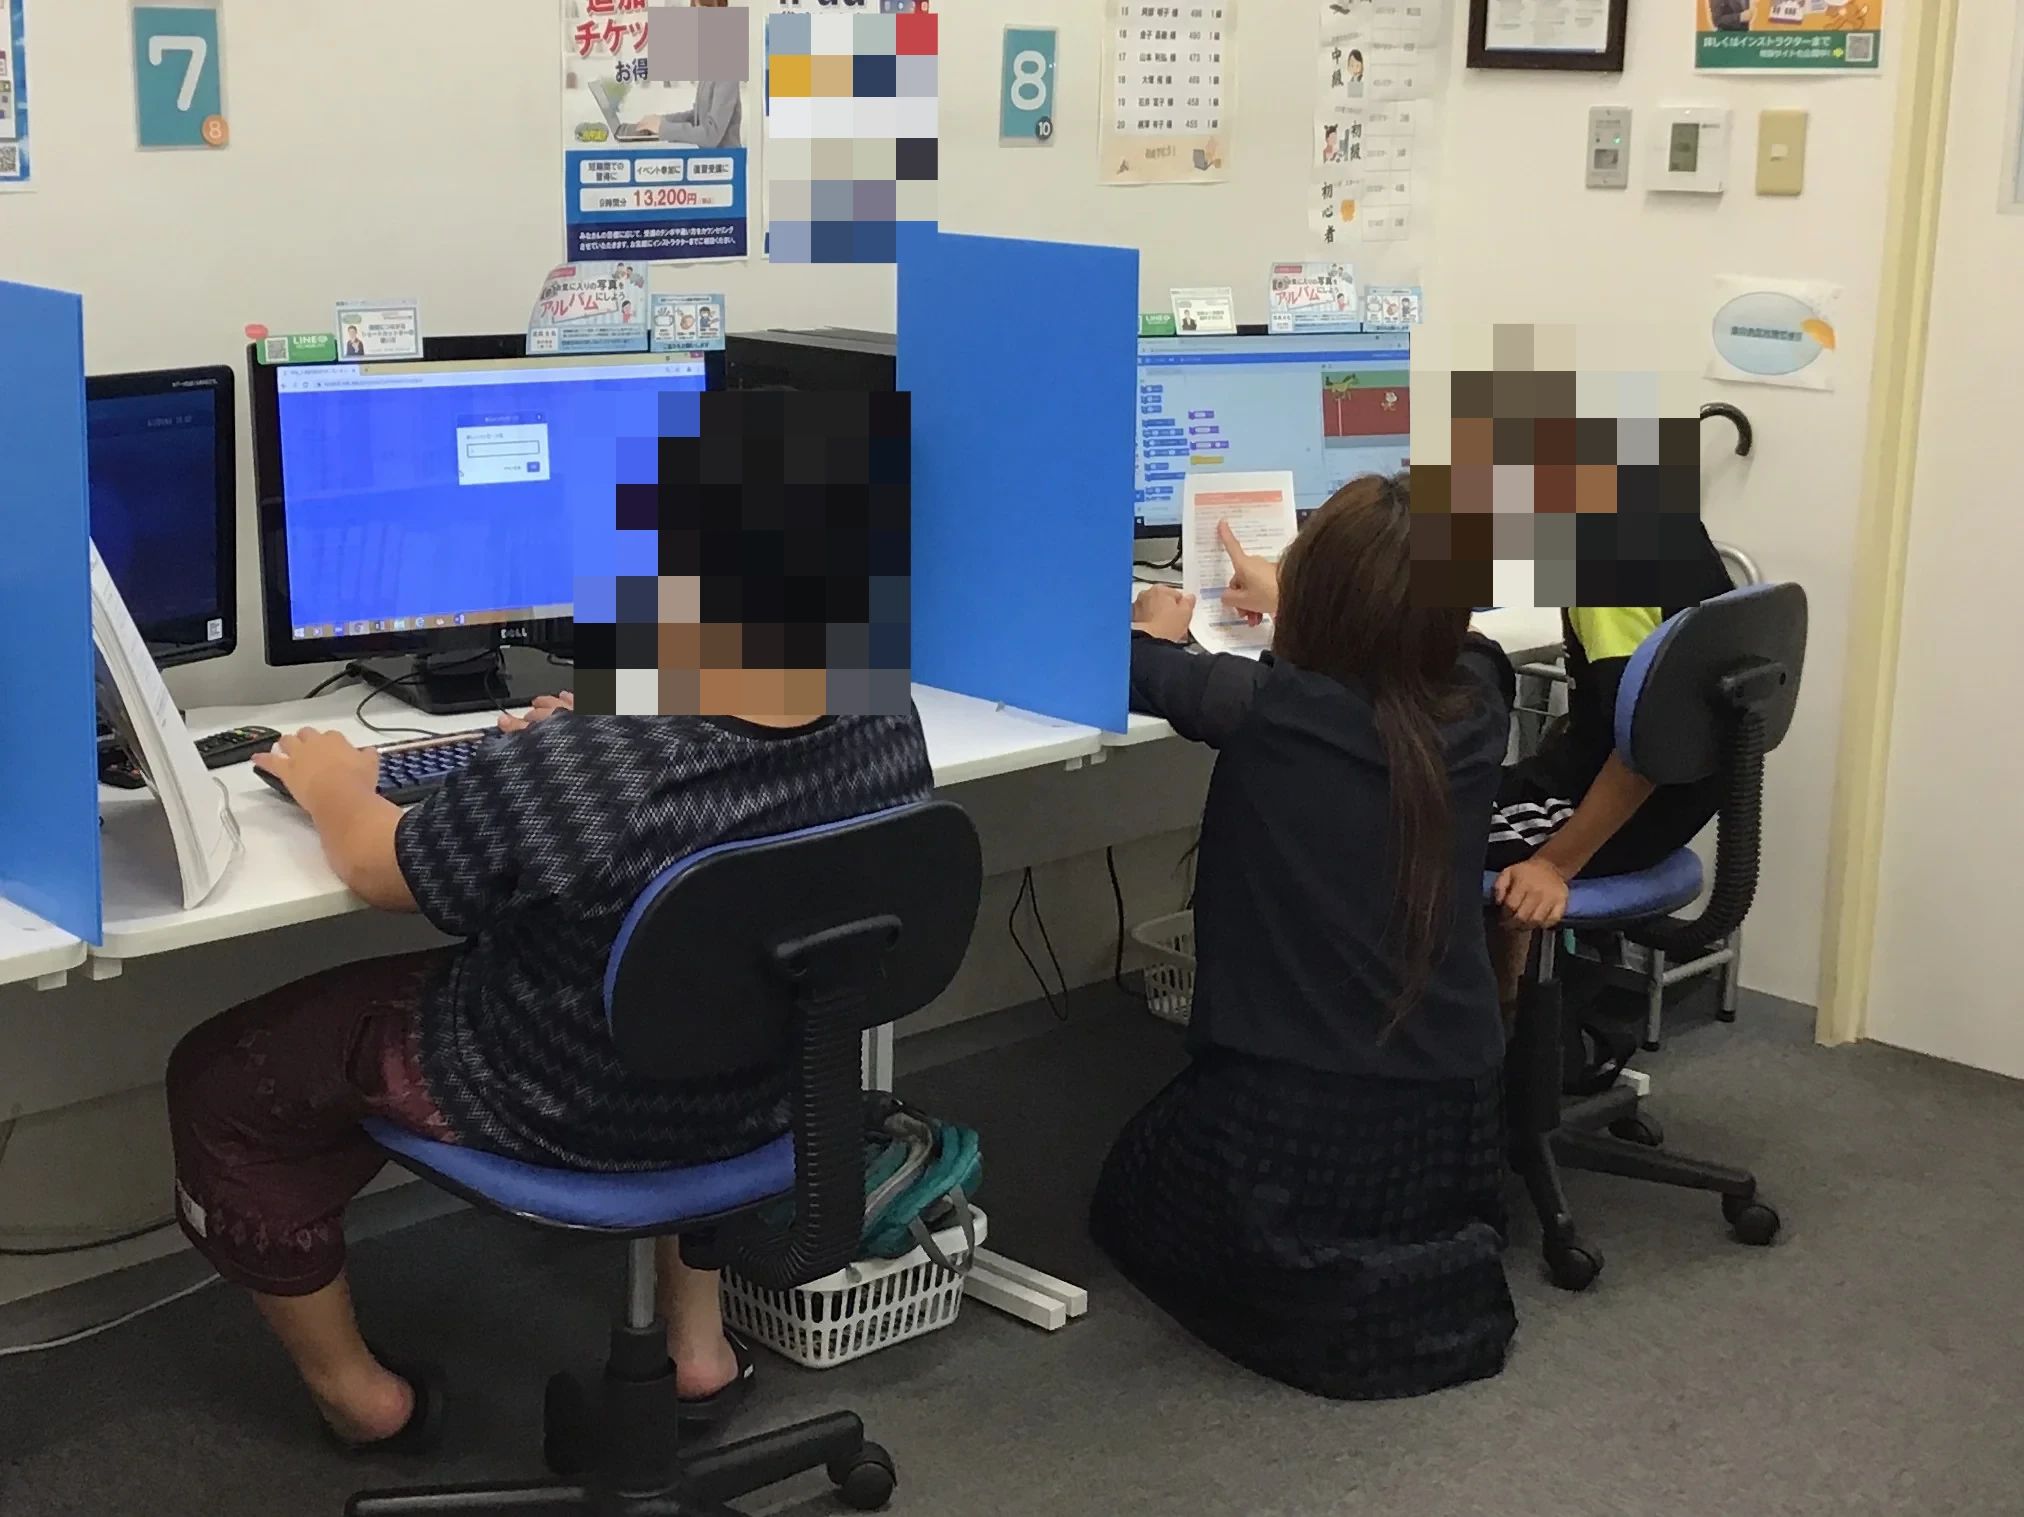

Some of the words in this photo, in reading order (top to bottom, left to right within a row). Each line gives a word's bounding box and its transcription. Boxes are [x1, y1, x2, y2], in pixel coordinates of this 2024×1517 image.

[148, 35, 207, 111] 7
[1011, 50, 1047, 111] 8
[210, 121, 222, 139] 8
[1038, 121, 1051, 137] 10
[634, 188, 698, 208] 13,200円
[540, 292, 600, 318] アルバム
[1274, 285, 1321, 306] アルバム
